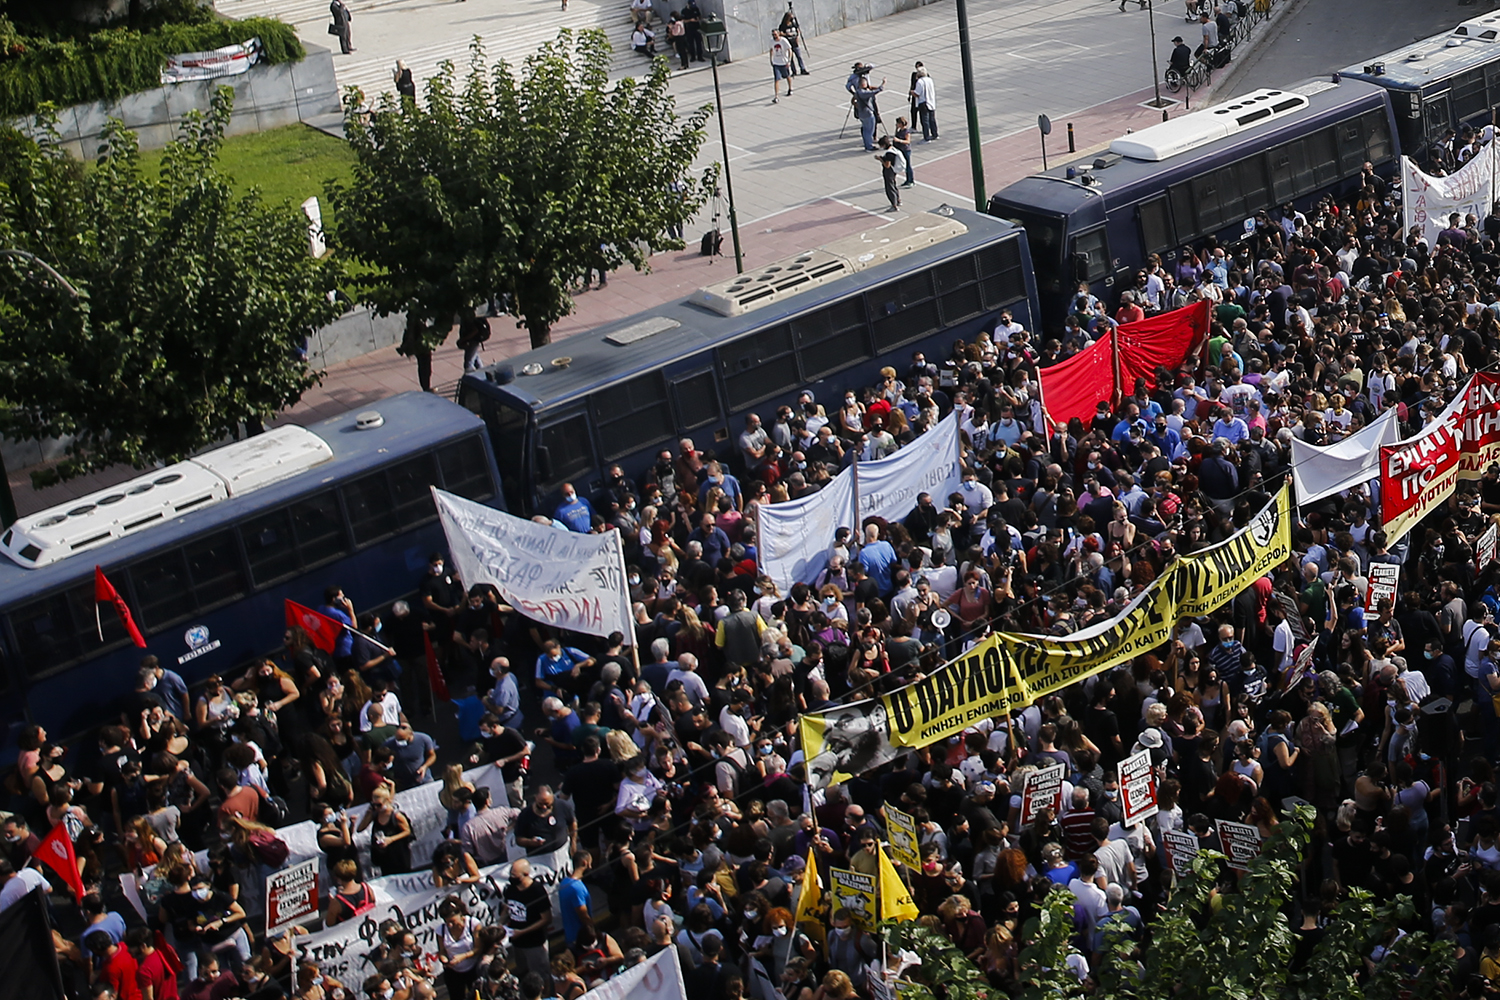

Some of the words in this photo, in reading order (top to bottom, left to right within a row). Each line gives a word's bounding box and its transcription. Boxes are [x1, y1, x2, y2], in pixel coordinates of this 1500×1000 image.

[892, 687, 914, 733] Ο
[1209, 533, 1256, 588] ΝΑΖΙ
[920, 716, 964, 739] ΚΙΝΗΣΗ
[967, 691, 1024, 720] ΕΝΩΜΕΝΟΙ
[1060, 663, 1080, 680] ΣΤΟ
[1134, 632, 1152, 650] ΚΑΙ
[1152, 627, 1169, 645] ΤΗ
[1210, 581, 1240, 607] ΑΠΕΙΛΗ
[1123, 756, 1147, 775] ΤΣΑΚΙΣΤΕ
[1030, 769, 1059, 786] ΤΣΑΚΙΣΤΕ
[1130, 785, 1148, 800] ΙΣΟΒΙΑ
[1223, 825, 1253, 836] ΤΣΑΚΙΣΤΕ
[1166, 834, 1193, 847] ΤΣΑΚΙΣΤΕ
[275, 864, 313, 888] ΤΣΑΚΙΣΤΕ
